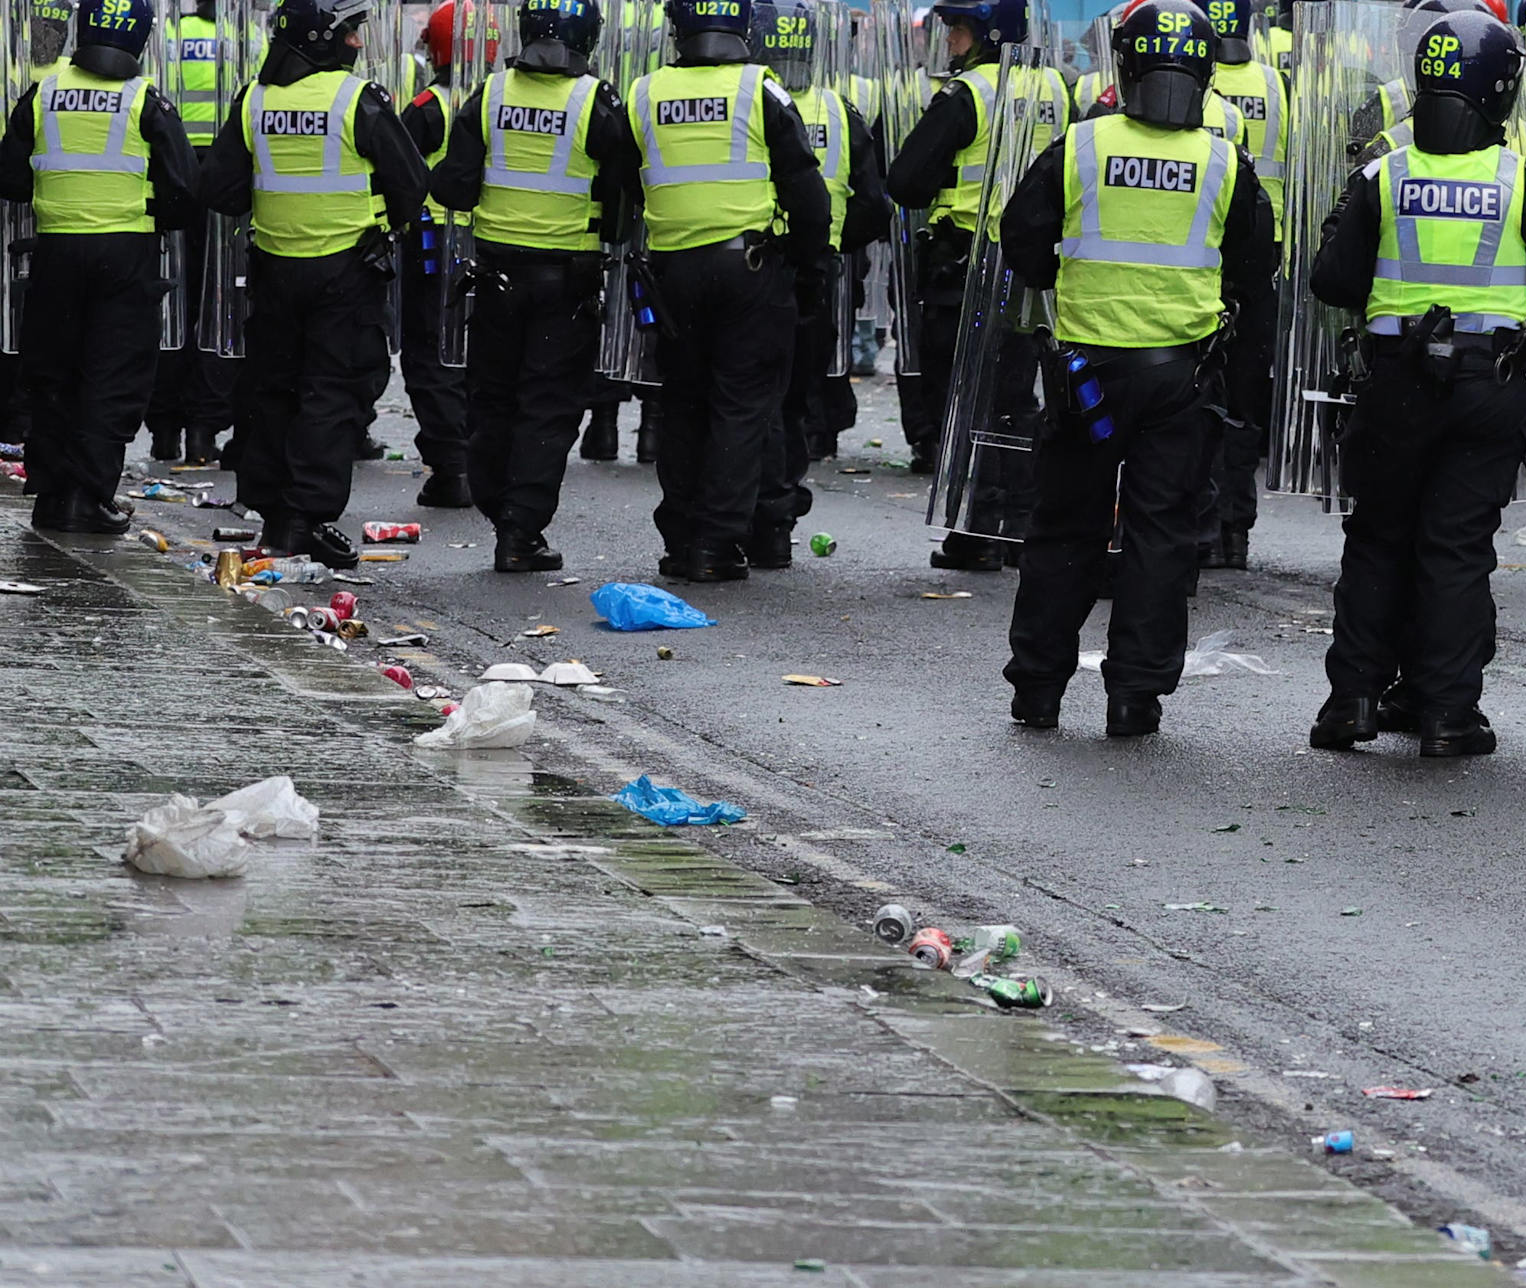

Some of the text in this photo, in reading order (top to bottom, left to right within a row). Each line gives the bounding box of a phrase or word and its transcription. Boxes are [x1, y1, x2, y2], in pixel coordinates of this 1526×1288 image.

[696, 3, 740, 17] U270
[1208, 1, 1235, 20] SP
[88, 13, 137, 32] L277
[1157, 12, 1191, 33] SP
[183, 39, 215, 61] POL
[1135, 36, 1207, 59] G1746
[1427, 34, 1461, 59] SP
[1420, 58, 1462, 79] G94
[53, 90, 120, 113] POLICE
[659, 98, 727, 124] POLICE
[263, 111, 327, 135] POLICE
[499, 106, 565, 135] POLICE
[1109, 157, 1194, 192] POLICE
[1402, 183, 1498, 216] POLICE
